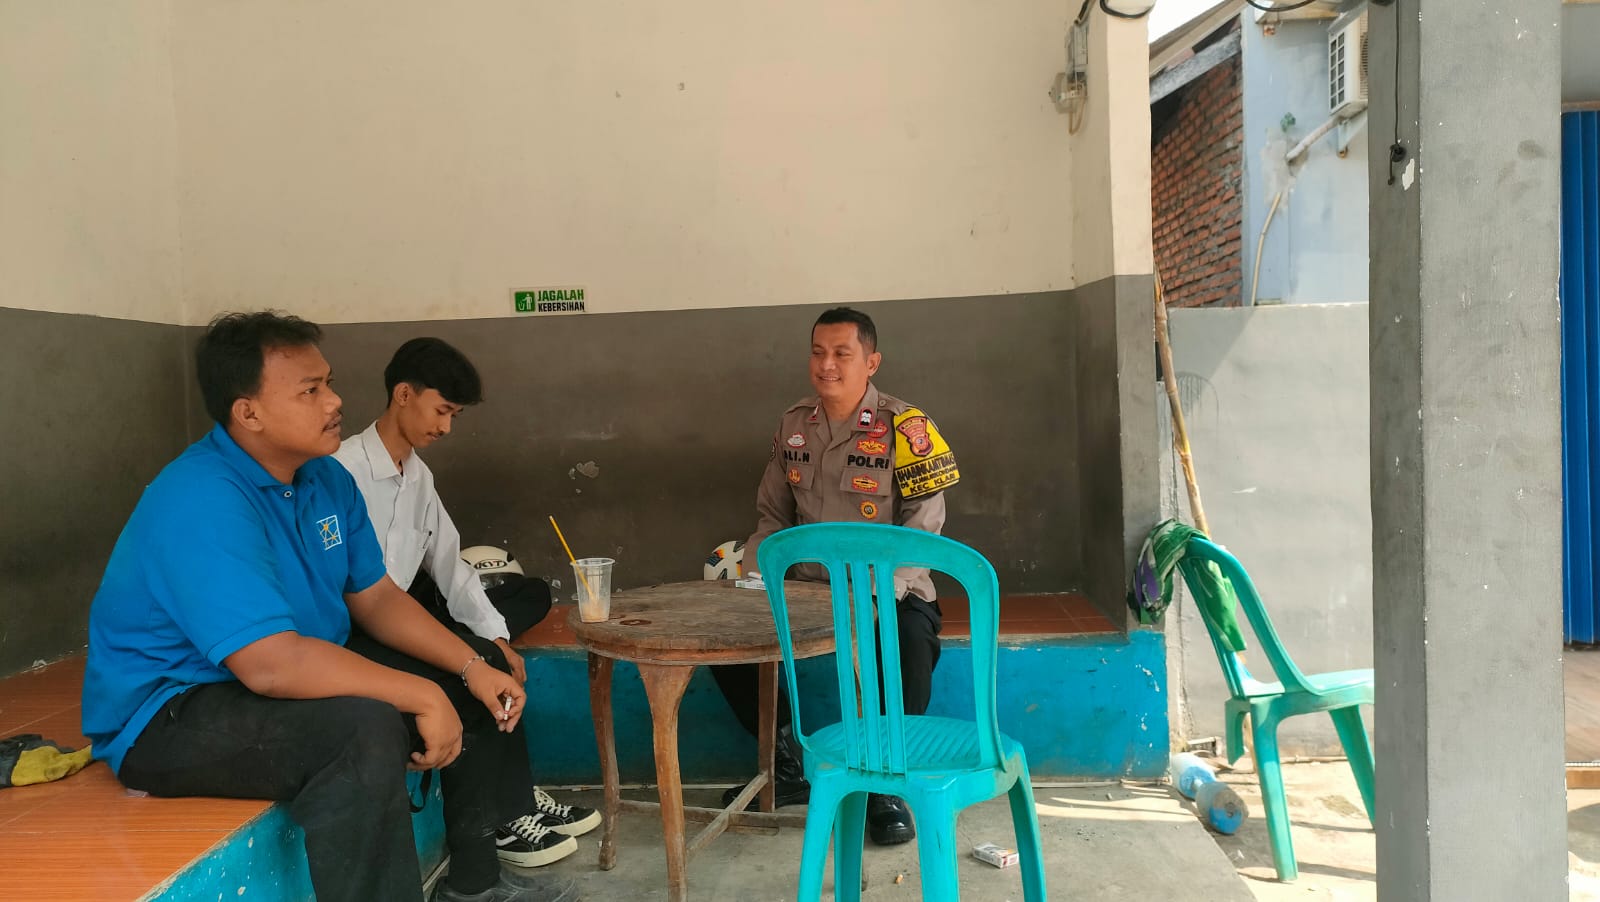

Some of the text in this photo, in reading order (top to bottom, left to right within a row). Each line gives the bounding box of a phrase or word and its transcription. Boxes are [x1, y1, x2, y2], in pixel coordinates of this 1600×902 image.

[538, 289, 584, 301] JAGALAH
[538, 302, 585, 312] KEBERSIHAN
[848, 455, 890, 469] POLRI
[910, 483, 930, 494] KEC
